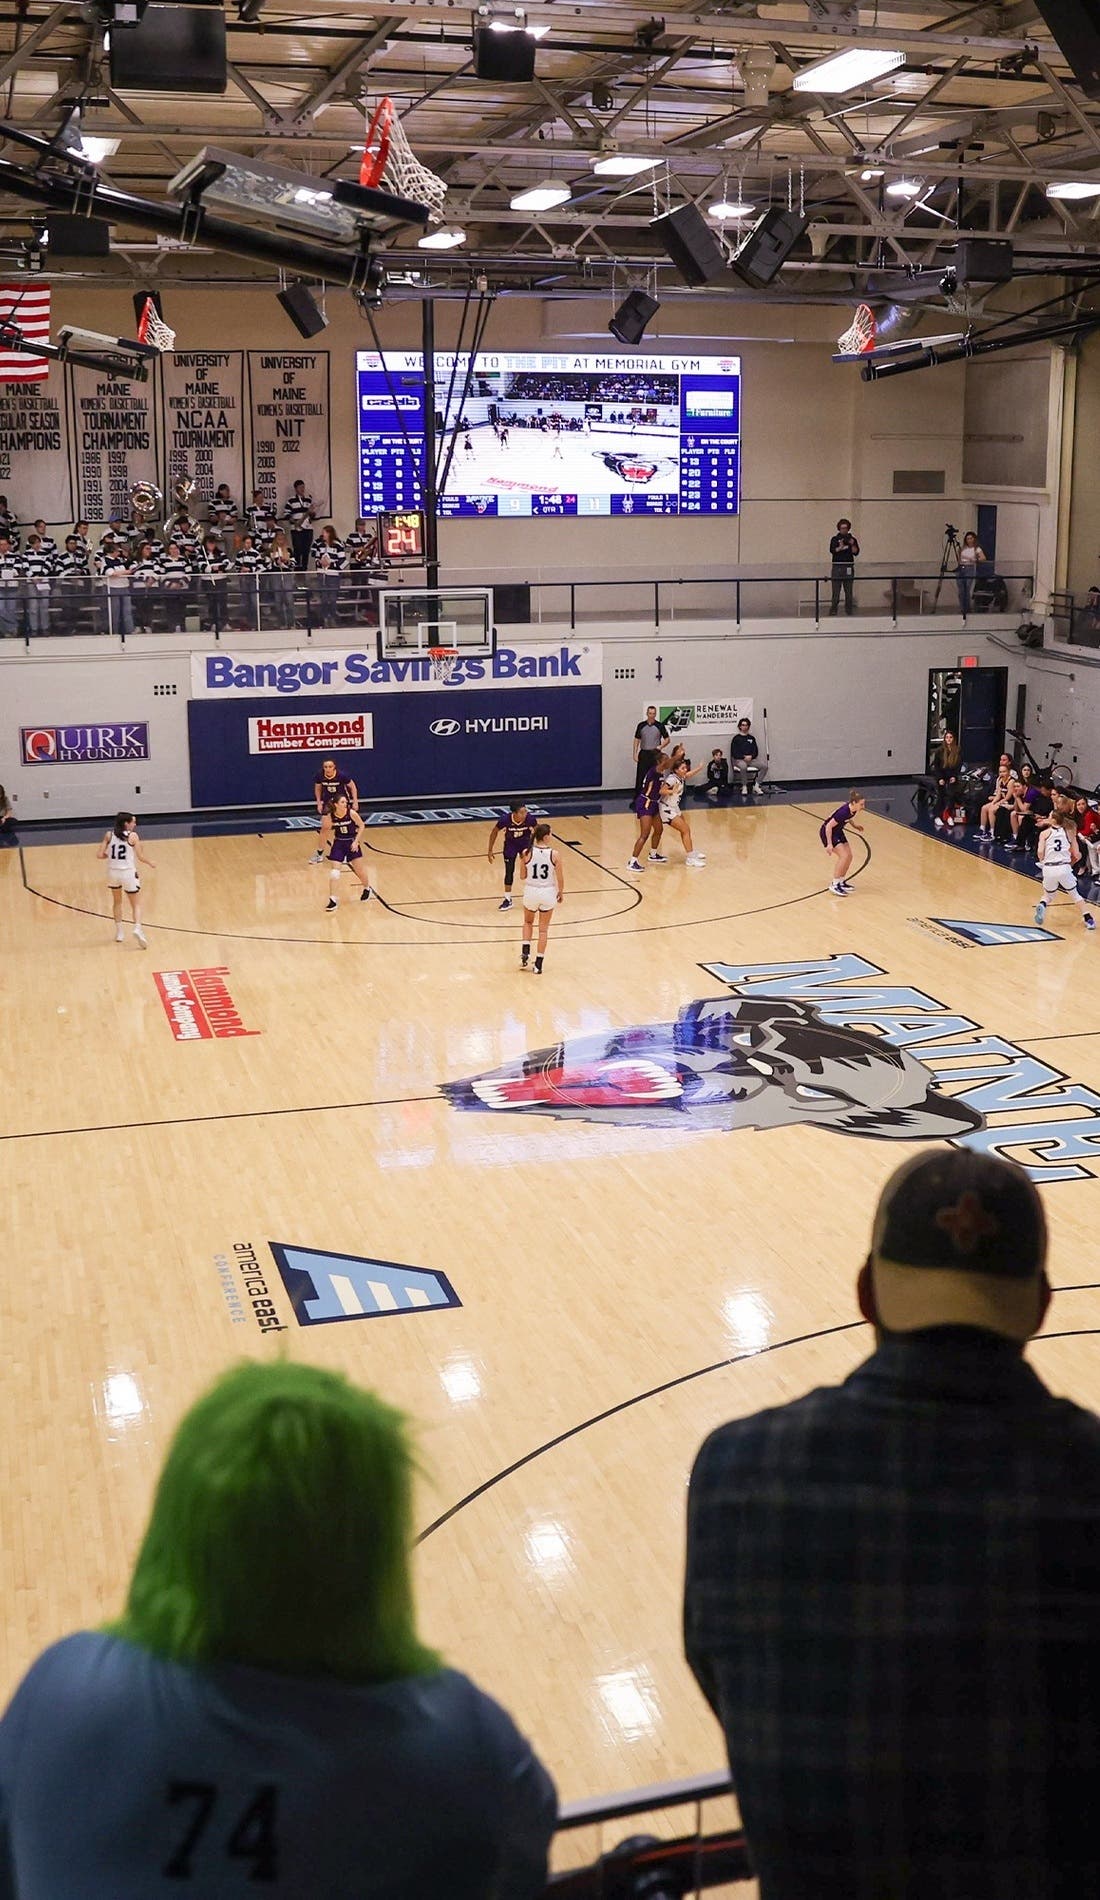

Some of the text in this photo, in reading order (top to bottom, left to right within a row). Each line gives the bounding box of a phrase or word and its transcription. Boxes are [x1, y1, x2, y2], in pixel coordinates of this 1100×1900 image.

[174, 354, 229, 367] UNIVERSITY
[261, 356, 316, 369] UNIVERSITY
[405, 356, 700, 370] WECOM TO THE PIT AT MEMORIAL GYM
[195, 368, 208, 380] OF
[283, 372, 296, 384] OF
[6, 383, 41, 396] MAINE
[96, 383, 131, 396] MAINE
[185, 382, 220, 395] MAINE
[272, 388, 307, 400] MAINE
[19, 397, 59, 410] BASKETBALL
[80, 398, 149, 410] WOMEN'S BASKETBALL
[169, 396, 236, 409] WOMEN'S BASKETBALL
[257, 403, 324, 416] WOMEN'S BASKETBALL
[29, 412, 59, 430] SEASON
[83, 412, 147, 430] TOURNAMENT
[177, 410, 229, 429] NCAA
[276, 419, 304, 437] NIT
[82, 432, 150, 450] CHAMPIONS
[172, 430, 235, 448] TOURNAMENT
[256, 440, 300, 453] 1990 2022
[108, 451, 126, 463] 1997
[170, 450, 213, 462] 1995 2000
[257, 456, 275, 468] 2003
[83, 465, 127, 478] 1990 1998
[195, 463, 213, 475] 2004
[258, 471, 276, 484] 2005
[84, 480, 128, 492] 1991 2004
[84, 494, 103, 506] 1995
[539, 495, 562, 504] 1:48
[84, 508, 103, 520] 1996
[388, 530, 416, 552] 24
[206, 656, 338, 693] Bangor
[344, 653, 486, 686] Savings
[697, 704, 738, 712] RENEWAL
[257, 715, 365, 737] Hammond
[465, 717, 549, 733] HYUNDAI
[26, 726, 144, 760] QUIRK
[260, 736, 362, 750] Lumber Company
[60, 747, 144, 760] HYUNDAI
[111, 844, 126, 860] 12
[1053, 839, 1062, 852] 3
[532, 864, 549, 879] 13
[160, 972, 203, 1040] Lumber Company
[189, 967, 262, 1038] Hammond
[696, 952, 1100, 1183] MAINE
[213, 1254, 246, 1324] CONFERENCE
[233, 1242, 288, 1334] america east
[162, 1780, 281, 1882] 74
